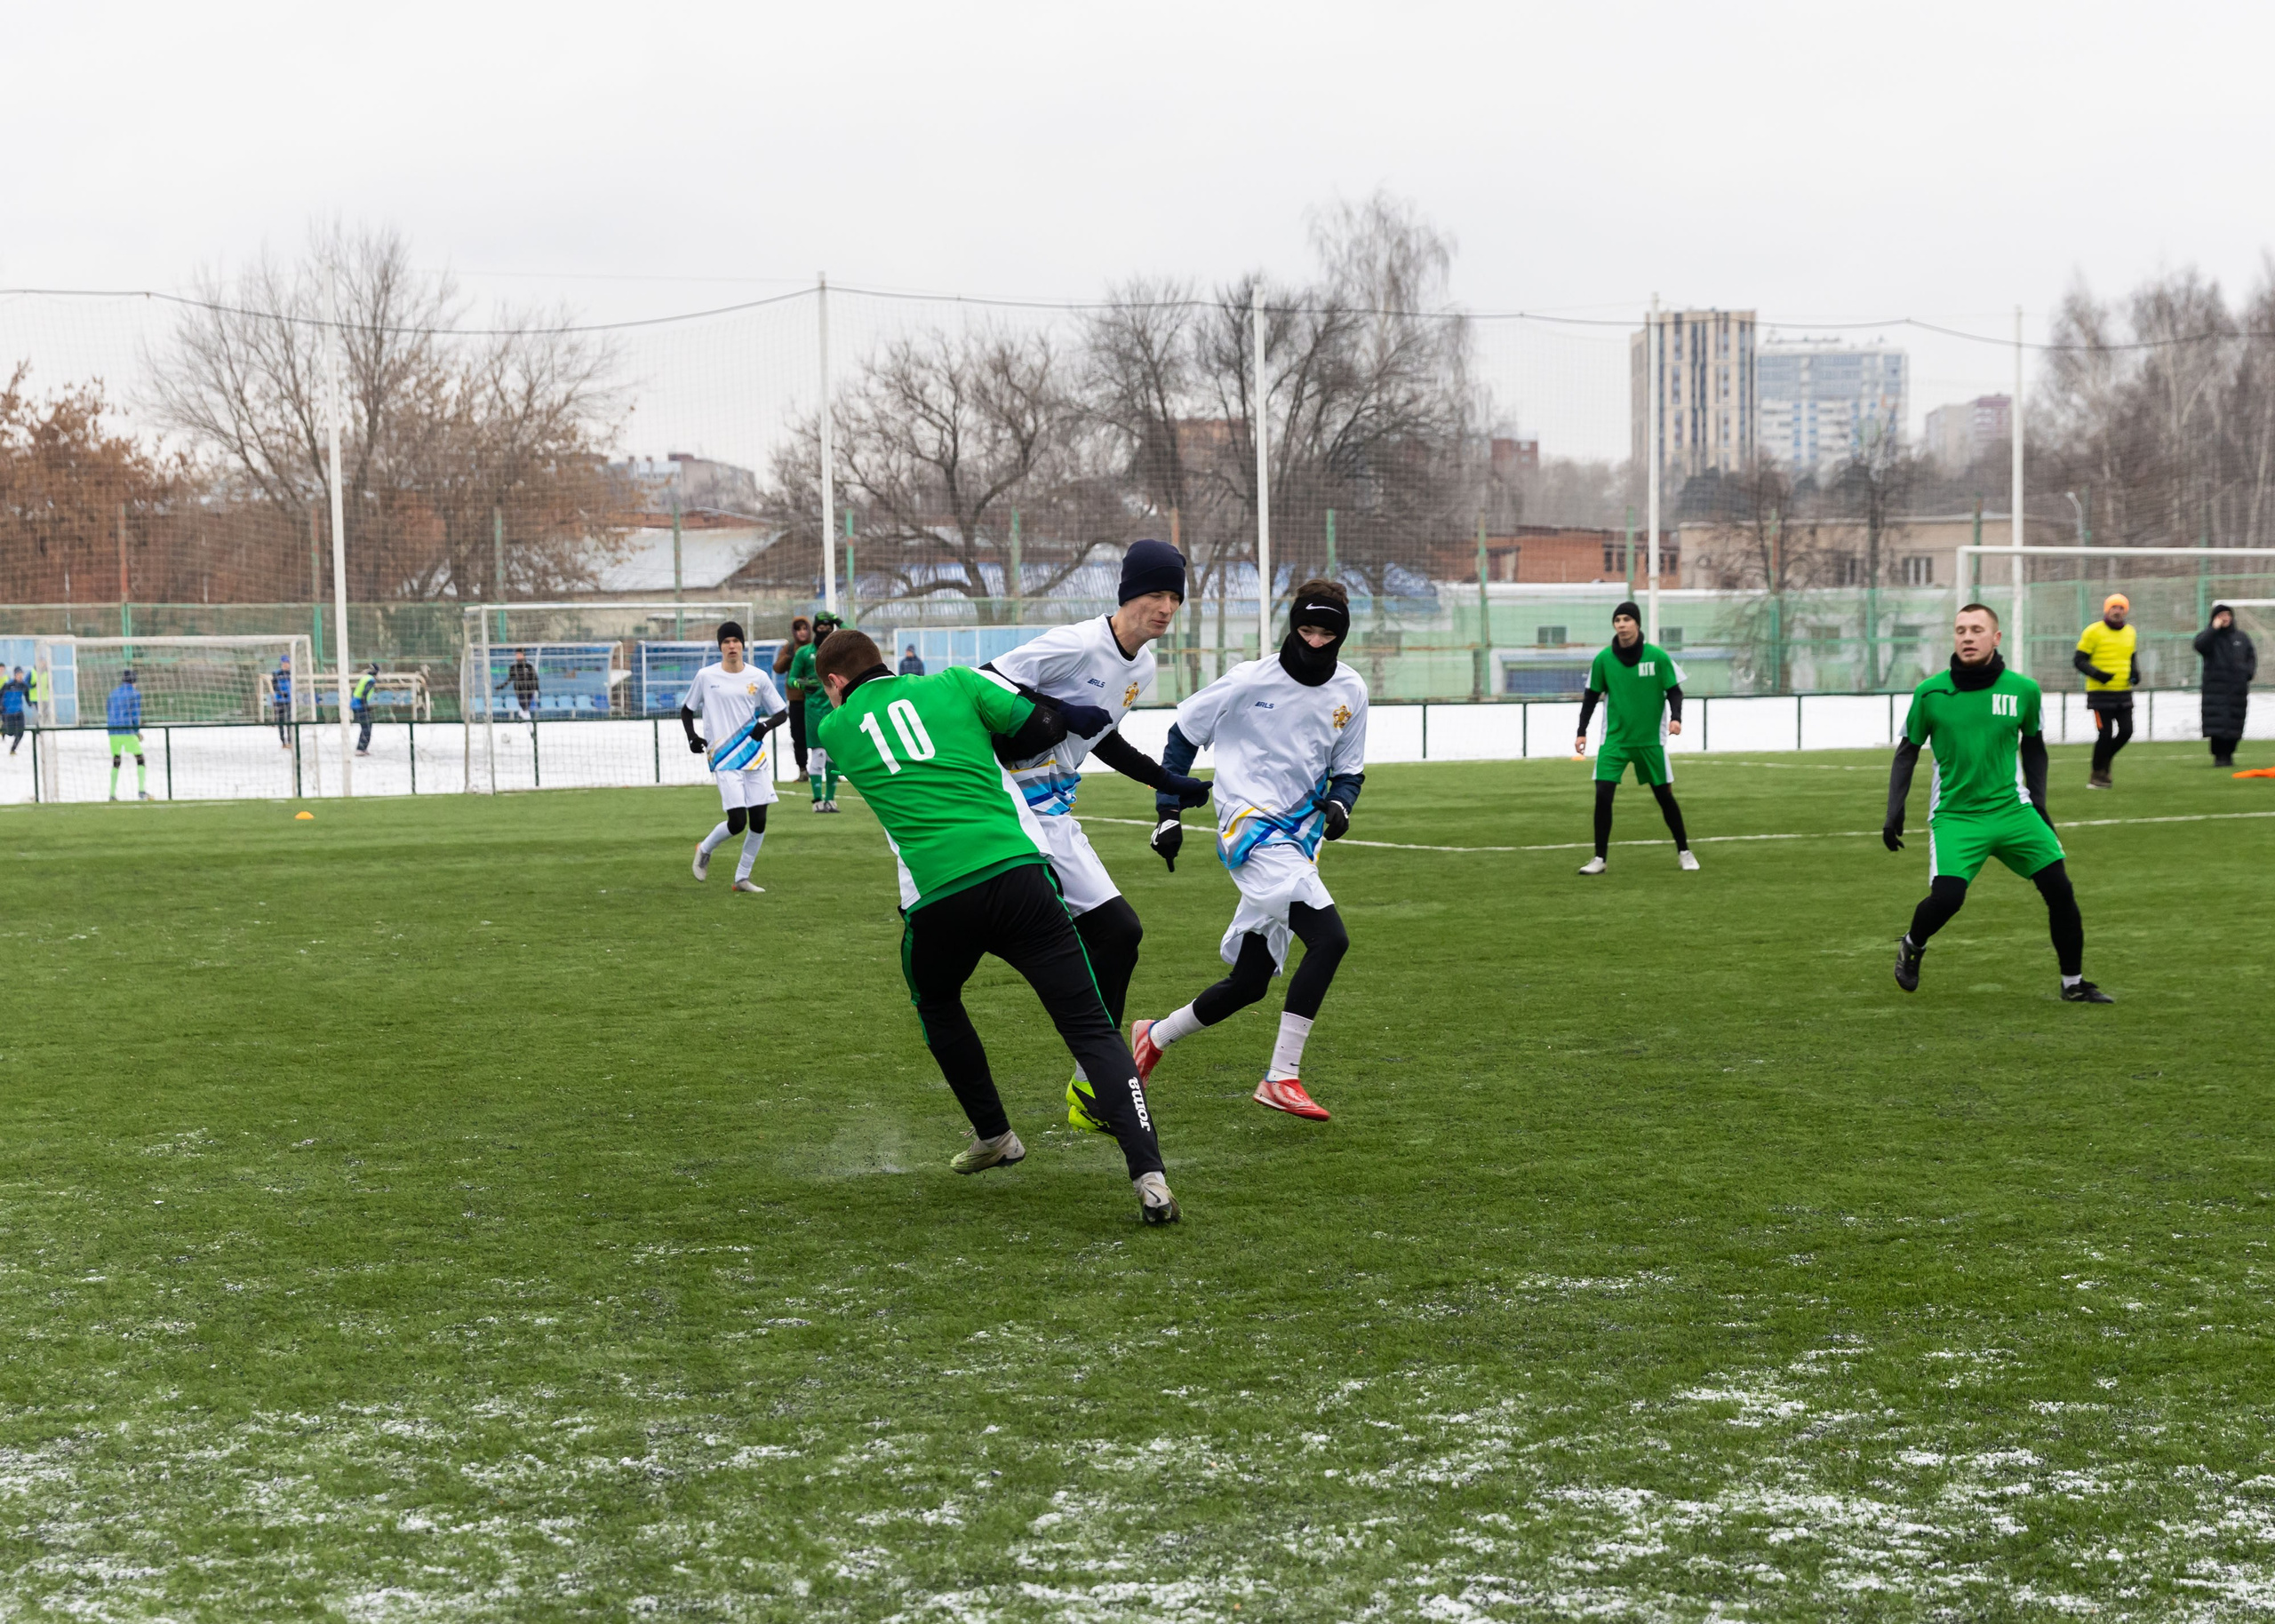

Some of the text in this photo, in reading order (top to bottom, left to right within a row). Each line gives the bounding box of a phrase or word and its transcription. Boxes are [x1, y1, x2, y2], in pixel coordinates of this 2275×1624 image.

[1992, 693, 2018, 717] КГК
[858, 698, 936, 775] 10
[1128, 1076, 1151, 1132] Joma
